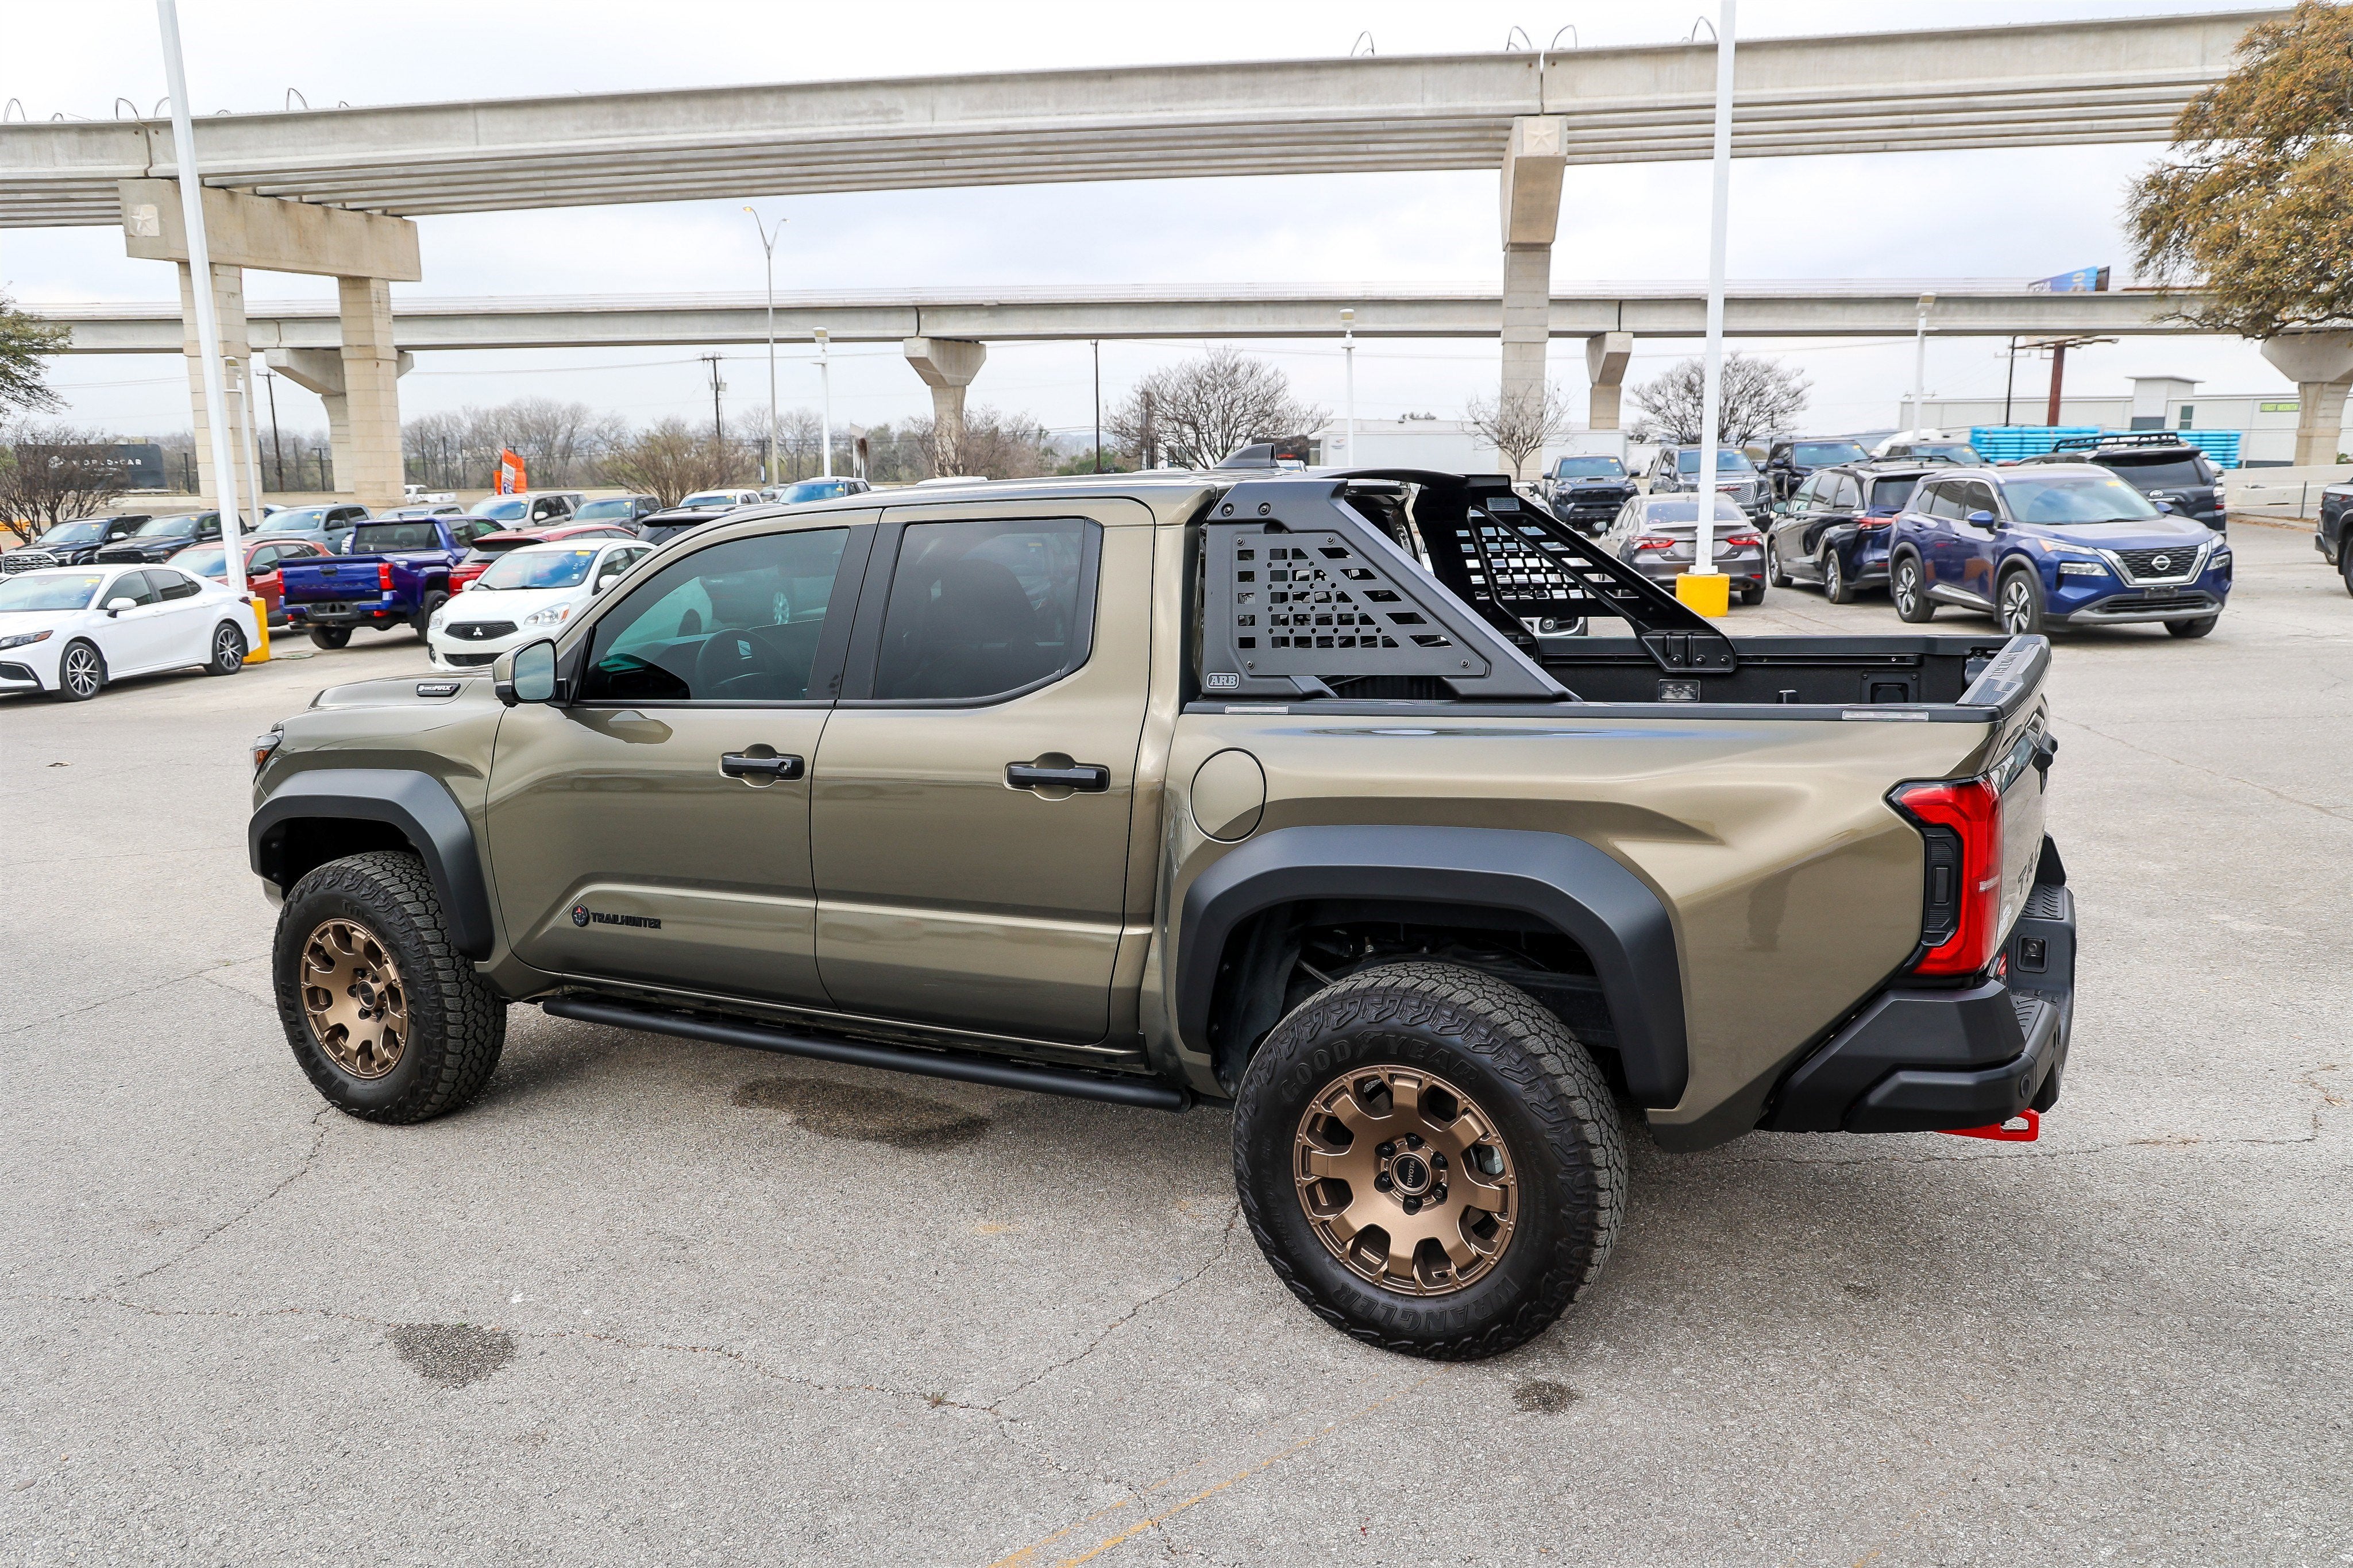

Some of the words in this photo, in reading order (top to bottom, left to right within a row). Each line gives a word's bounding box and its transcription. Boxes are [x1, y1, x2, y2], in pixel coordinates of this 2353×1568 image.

[1209, 675, 1236, 686] ARB
[591, 912, 661, 929] TRAILHUNTER
[1407, 1160, 1415, 1186] TOYOTA
[1333, 1276, 1520, 1332] WRANGLER
